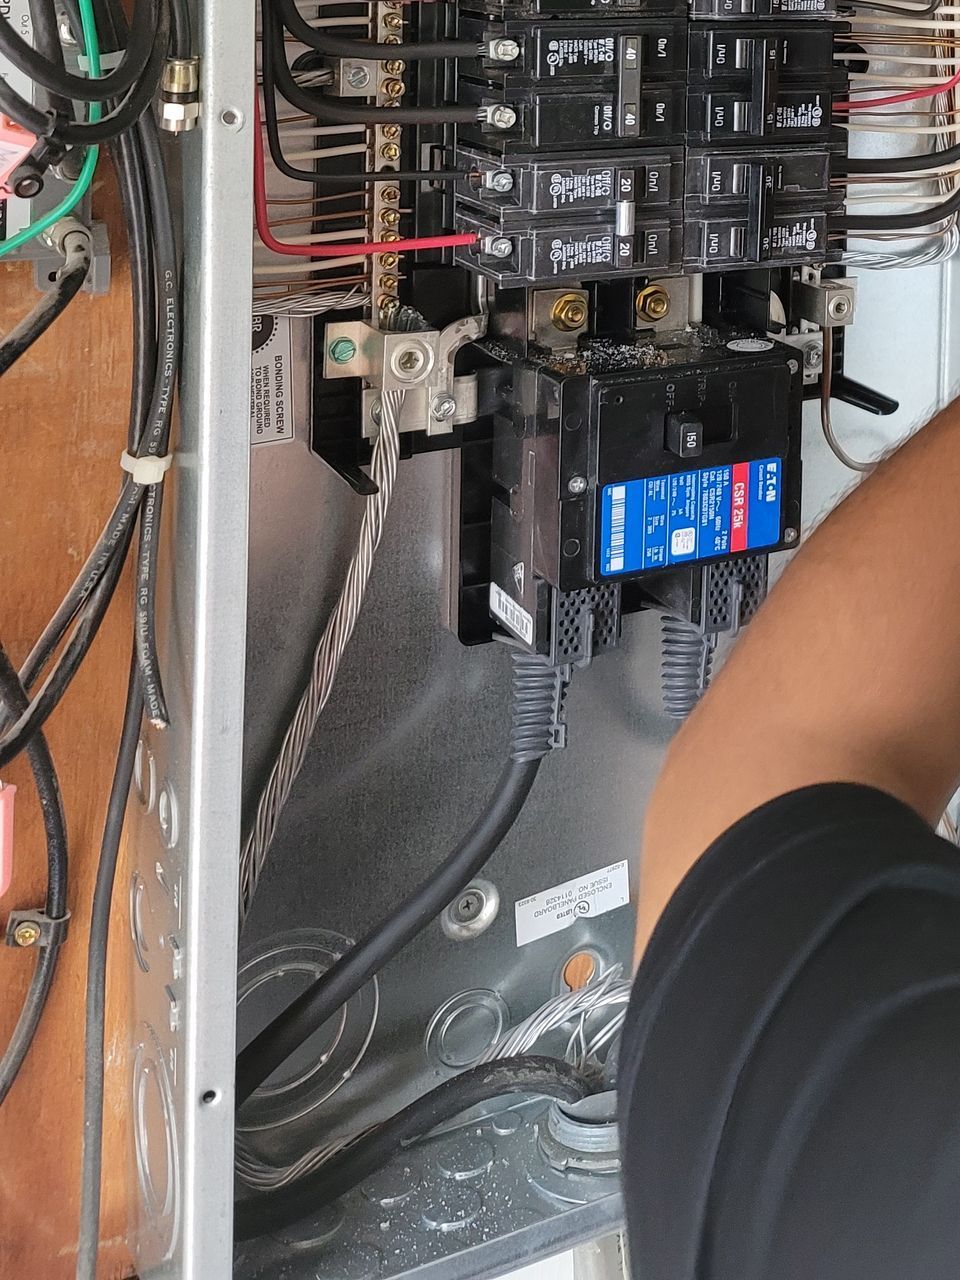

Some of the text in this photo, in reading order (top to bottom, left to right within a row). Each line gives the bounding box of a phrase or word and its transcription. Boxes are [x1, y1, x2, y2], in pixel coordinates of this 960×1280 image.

[626, 48, 636, 60] 40
[658, 38, 667, 57] On/I
[716, 44, 726, 64] On/I
[770, 50, 776, 60] 15
[626, 113, 635, 126] 40
[656, 103, 665, 122] On/I
[714, 106, 724, 126] On/I
[766, 114, 774, 124] 15
[622, 179, 631, 192] 20
[649, 172, 658, 192] On/I
[712, 171, 721, 191] On/I
[766, 176, 772, 188] 30
[620, 243, 630, 256] 20
[648, 234, 658, 254] On/I
[710, 234, 719, 253] On/I
[762, 238, 770, 250] 30
[164, 298, 175, 377] ELECTRONICS
[158, 386, 170, 414] TYPE
[254, 366, 264, 435] TO BOND GROUND
[262, 364, 272, 428] WHEN REQUIRED
[274, 355, 285, 434] BONDING SCREW
[153, 420, 164, 436] RG
[686, 432, 697, 448] 150
[702, 472, 710, 488] Style
[733, 482, 745, 528] CSR 25k
[98, 513, 130, 564] MADE IN
[140, 550, 150, 581] TYPE
[140, 587, 148, 606] RG
[142, 642, 153, 676] FOAM
[146, 684, 160, 718] MADE
[534, 882, 612, 918] ENCLOSED PANELBOARD
